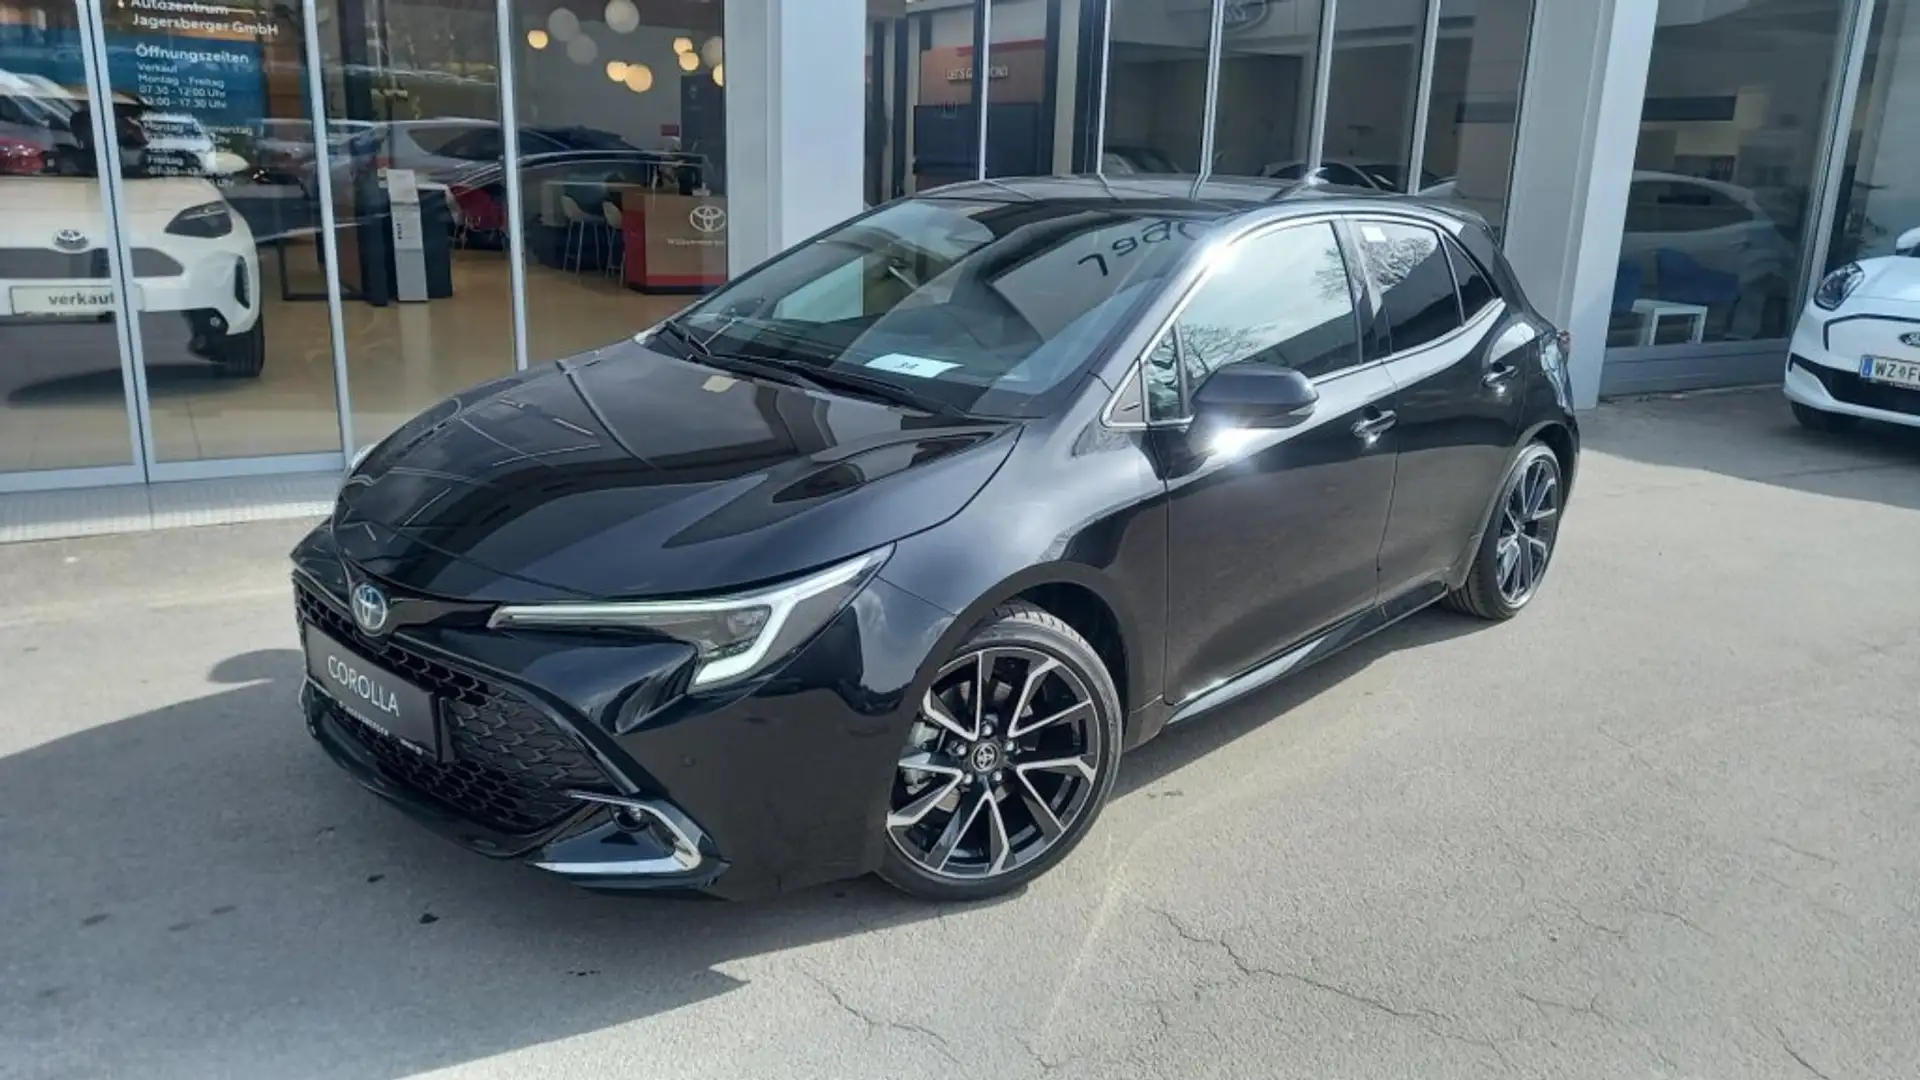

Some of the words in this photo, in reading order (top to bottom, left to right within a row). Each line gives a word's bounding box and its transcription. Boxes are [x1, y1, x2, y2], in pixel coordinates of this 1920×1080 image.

[132, 13, 229, 33] Jagersberger
[232, 21, 279, 36] GmbH
[135, 42, 249, 64] Öffnungszeiten
[136, 62, 178, 73] Verkauf
[137, 74, 180, 87] Montag
[188, 76, 225, 89] Freitag
[207, 88, 226, 98] Uhr
[208, 99, 227, 109] Uhr
[328, 655, 400, 717] COROLLA
